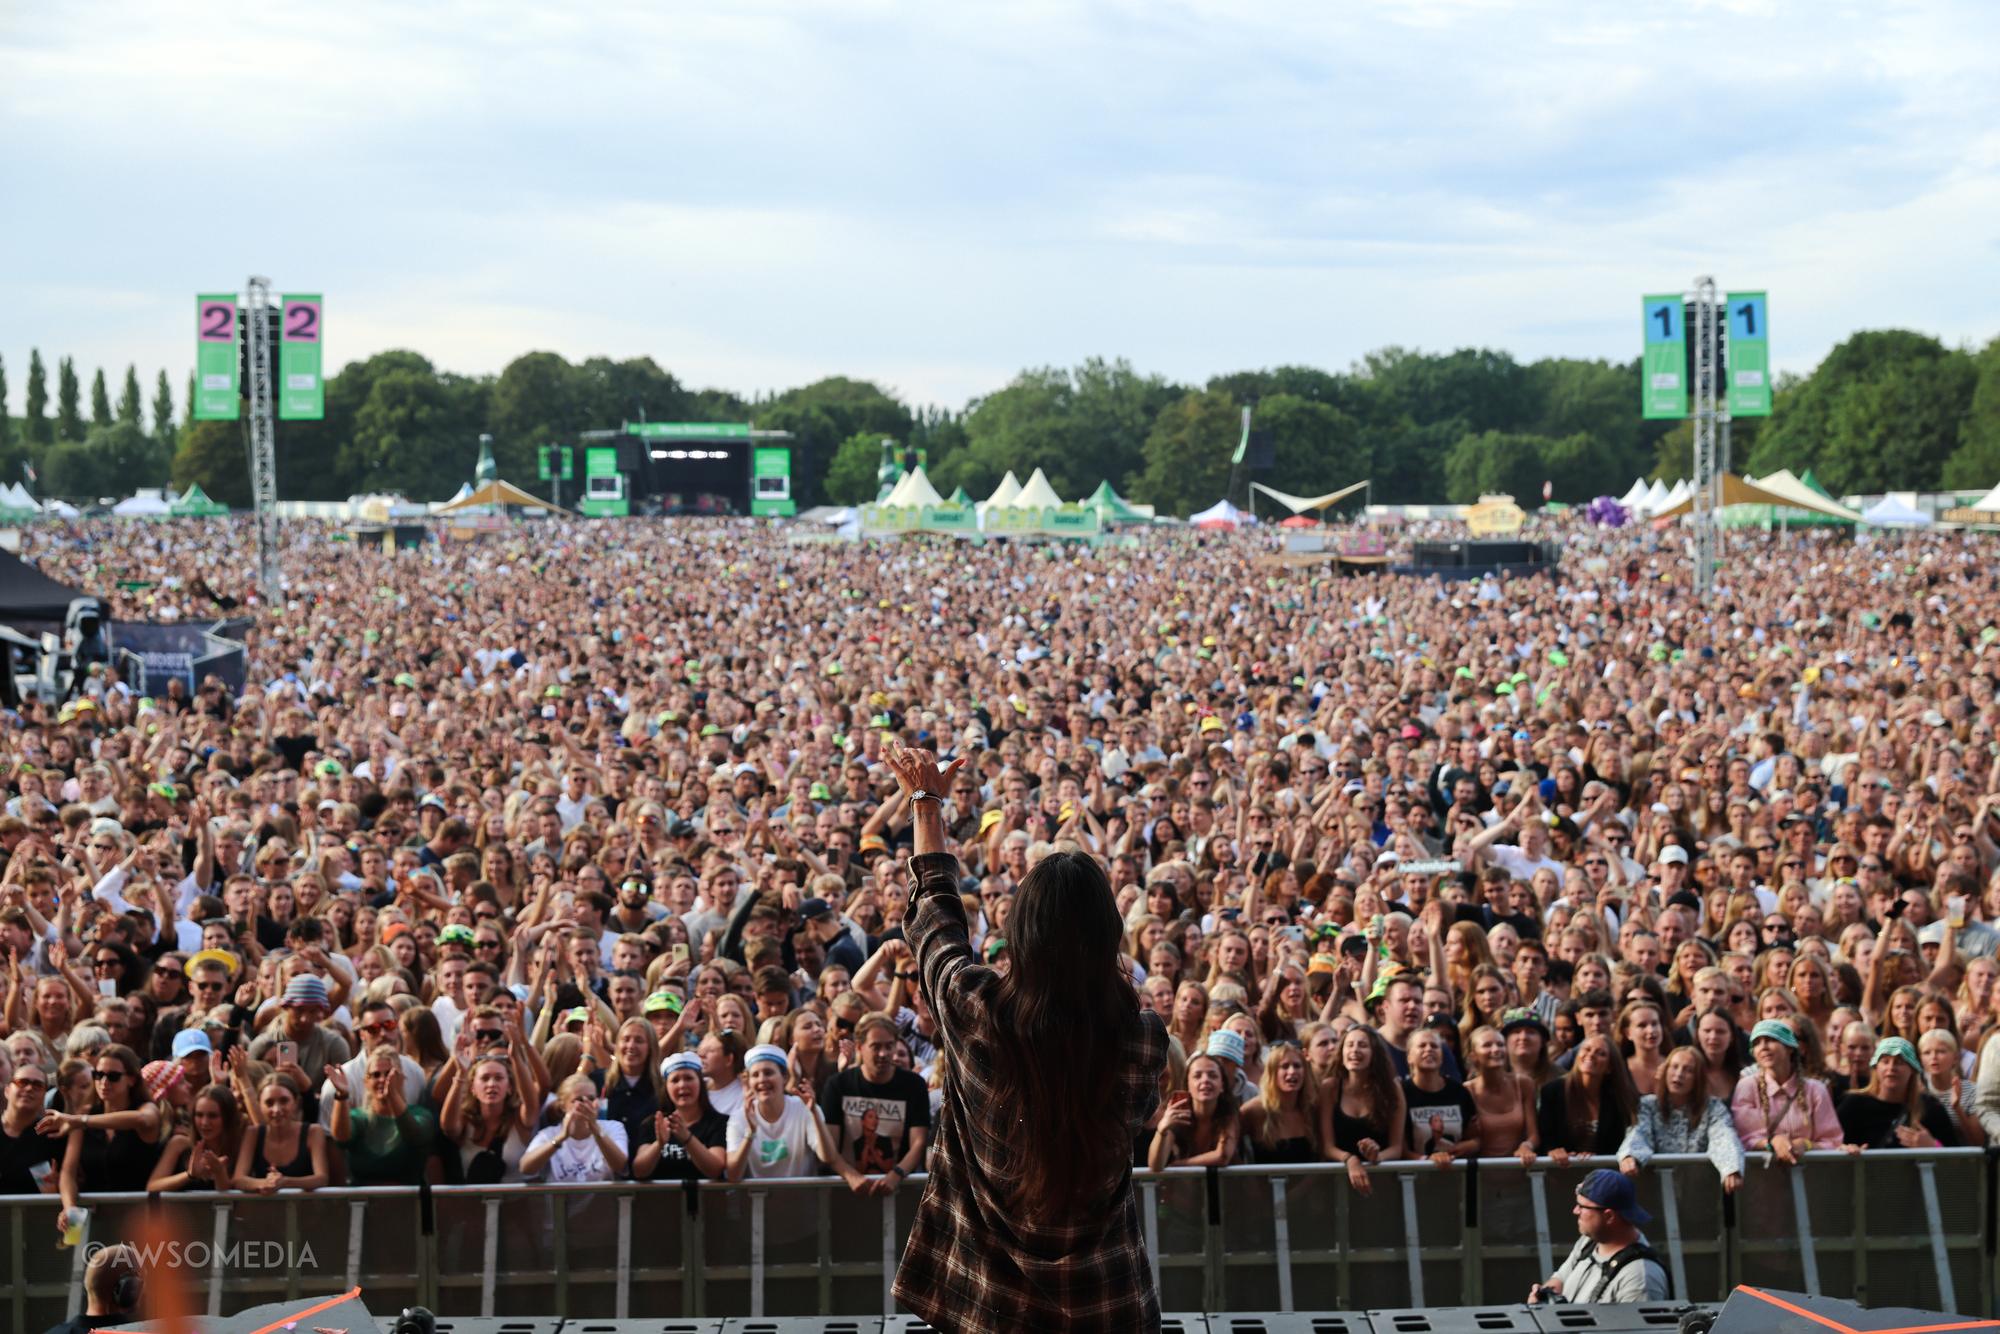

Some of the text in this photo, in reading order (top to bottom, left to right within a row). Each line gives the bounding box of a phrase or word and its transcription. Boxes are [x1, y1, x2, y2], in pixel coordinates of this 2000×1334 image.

[202, 306, 231, 338] 2
[286, 306, 316, 338] 2
[1653, 306, 1671, 337] 1
[1737, 303, 1755, 335] 1
